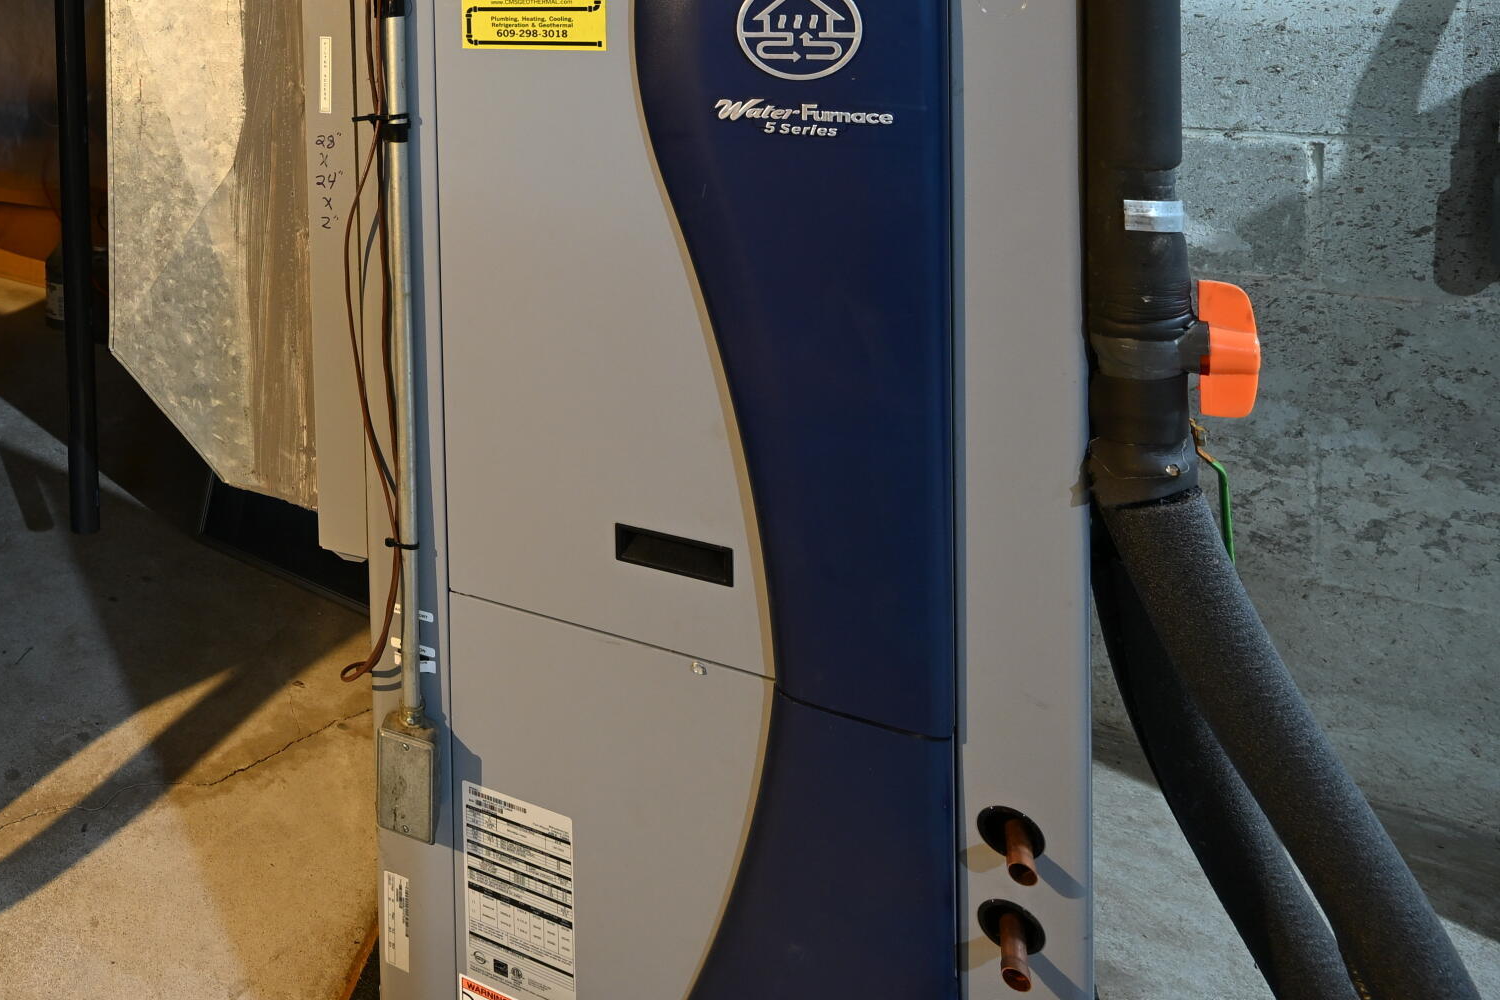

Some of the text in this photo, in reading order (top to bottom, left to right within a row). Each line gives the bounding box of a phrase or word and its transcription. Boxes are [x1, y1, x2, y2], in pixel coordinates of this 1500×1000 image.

[496, 29, 568, 38] 609-298-3018
[764, 121, 838, 137] 5 Series
